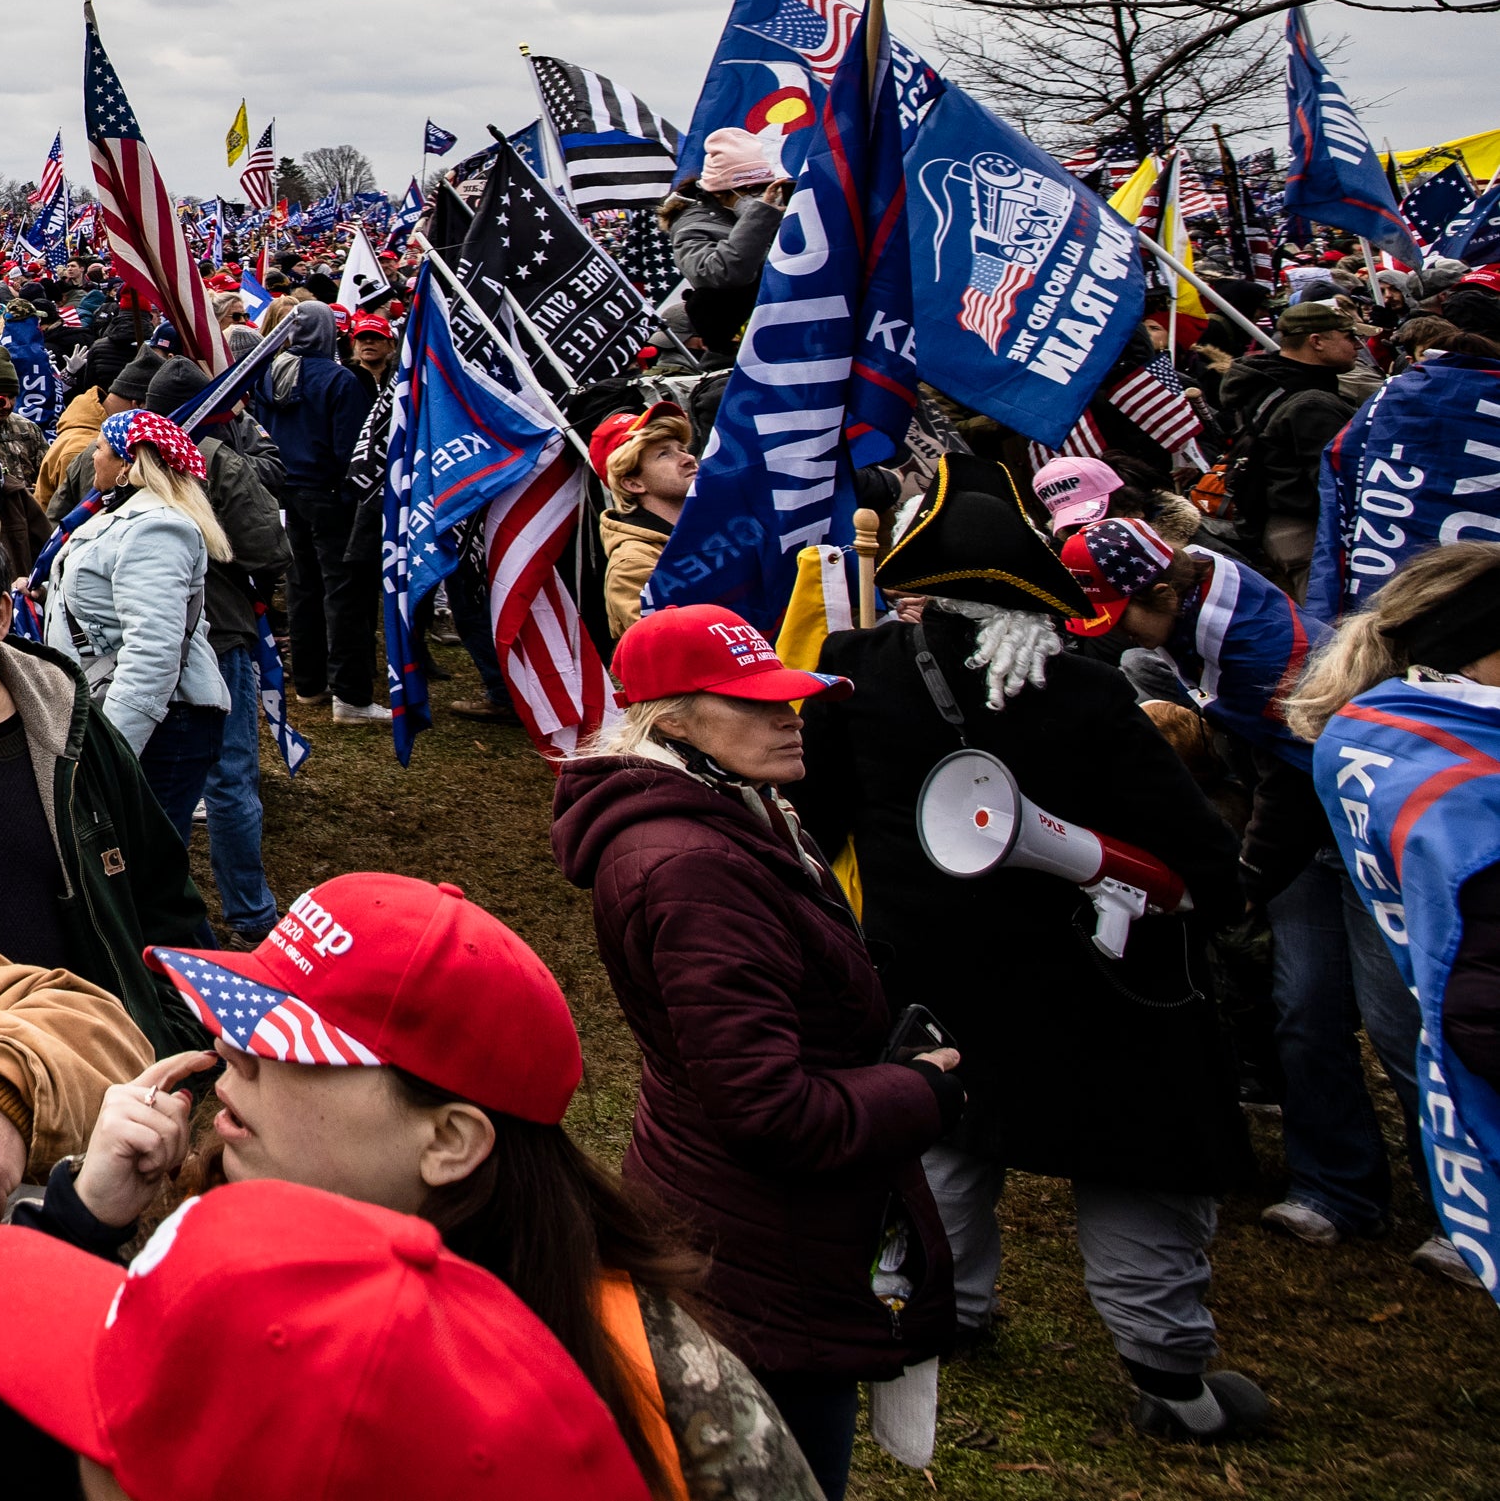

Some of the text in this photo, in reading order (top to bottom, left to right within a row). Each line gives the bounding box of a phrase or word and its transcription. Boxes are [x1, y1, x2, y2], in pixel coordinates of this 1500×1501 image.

[707, 622, 767, 646] Tru
[736, 653, 756, 667] KEEP
[1038, 812, 1066, 836] PYLE
[285, 944, 314, 976] GREAT!
